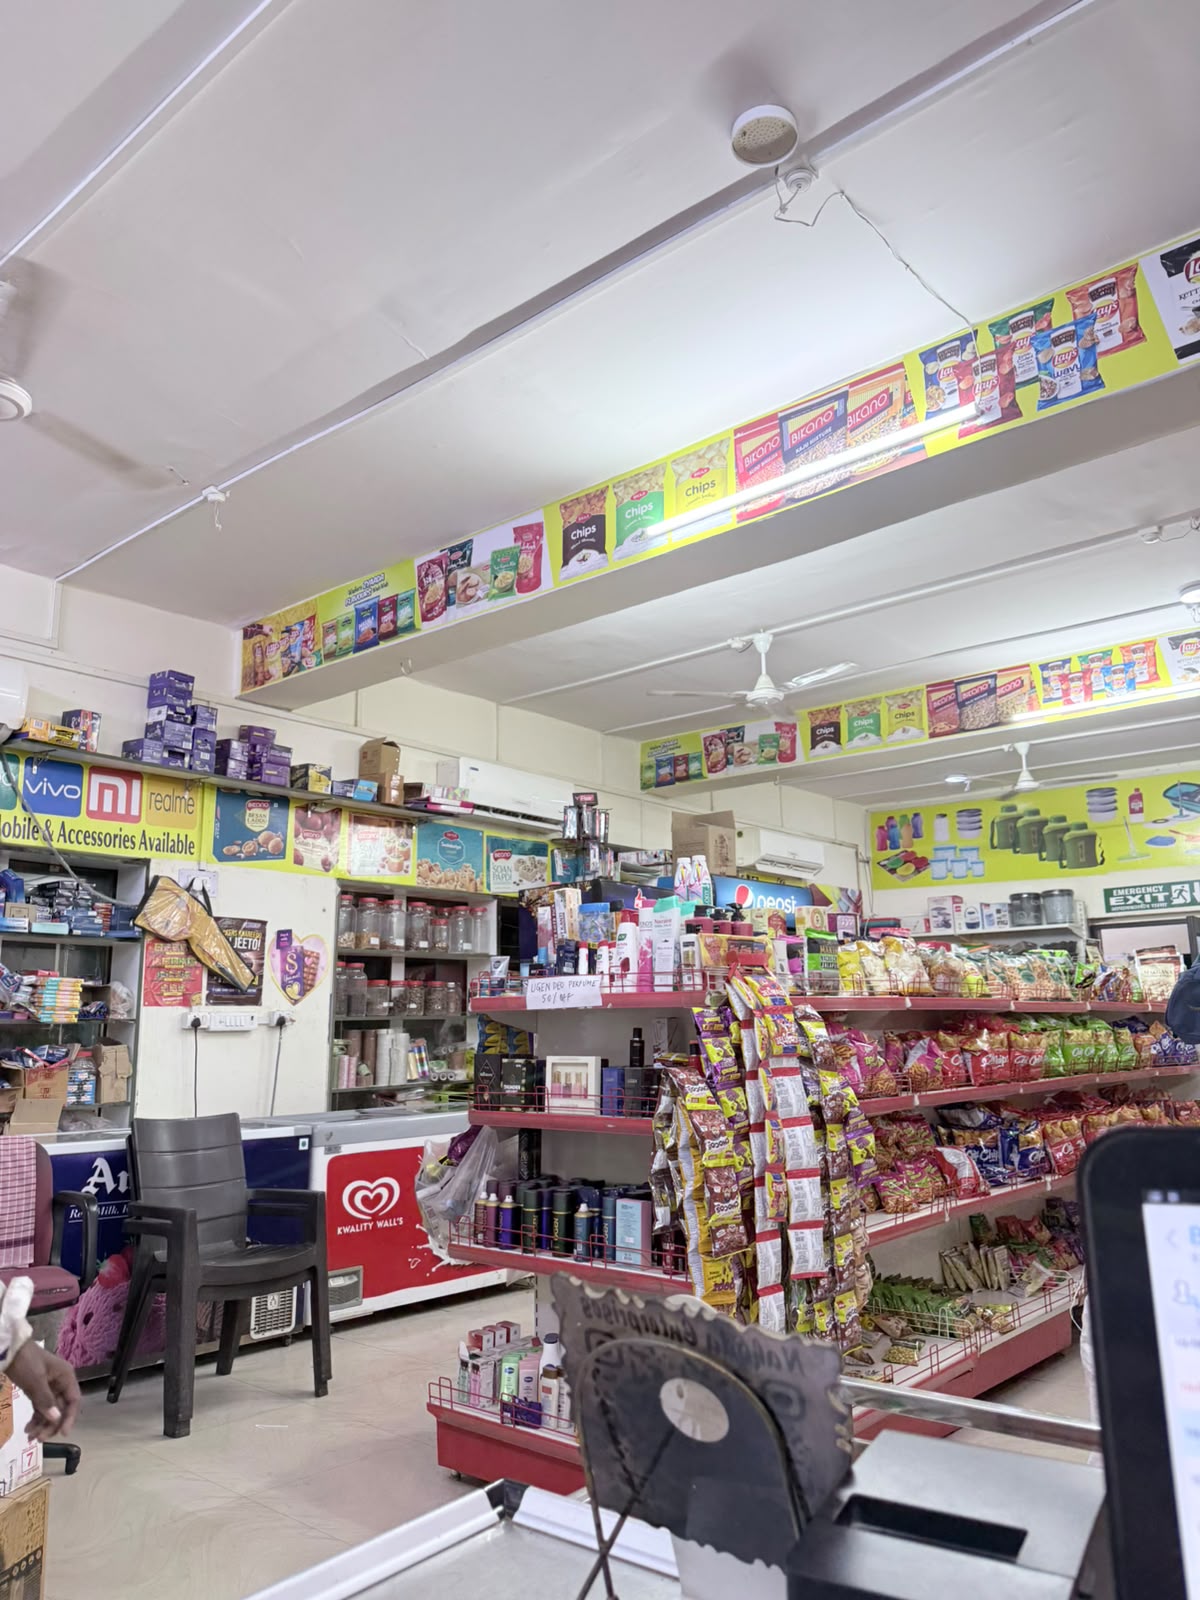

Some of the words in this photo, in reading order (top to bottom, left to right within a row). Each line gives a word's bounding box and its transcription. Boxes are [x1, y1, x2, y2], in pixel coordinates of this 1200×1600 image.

[1094, 300, 1119, 318] ay's
[685, 479, 717, 497] Chips
[625, 501, 654, 519] Chips
[570, 524, 597, 541] Chips
[853, 717, 874, 728] Chips
[894, 710, 915, 721] Chips
[816, 725, 834, 736] Chips
[25, 777, 81, 799] vivo
[149, 788, 195, 815] realme
[0, 814, 39, 841] obile
[42, 819, 54, 841] &
[57, 821, 136, 850] Accessories
[138, 829, 195, 856] Available
[1109, 892, 1169, 906] EXIT
[1112, 885, 1164, 896] EMERGENCY
[757, 895, 797, 914] pepsi
[337, 1221, 374, 1236] KWALITY
[376, 1216, 404, 1228] WALL'S
[26, 1451, 34, 1468] 7
